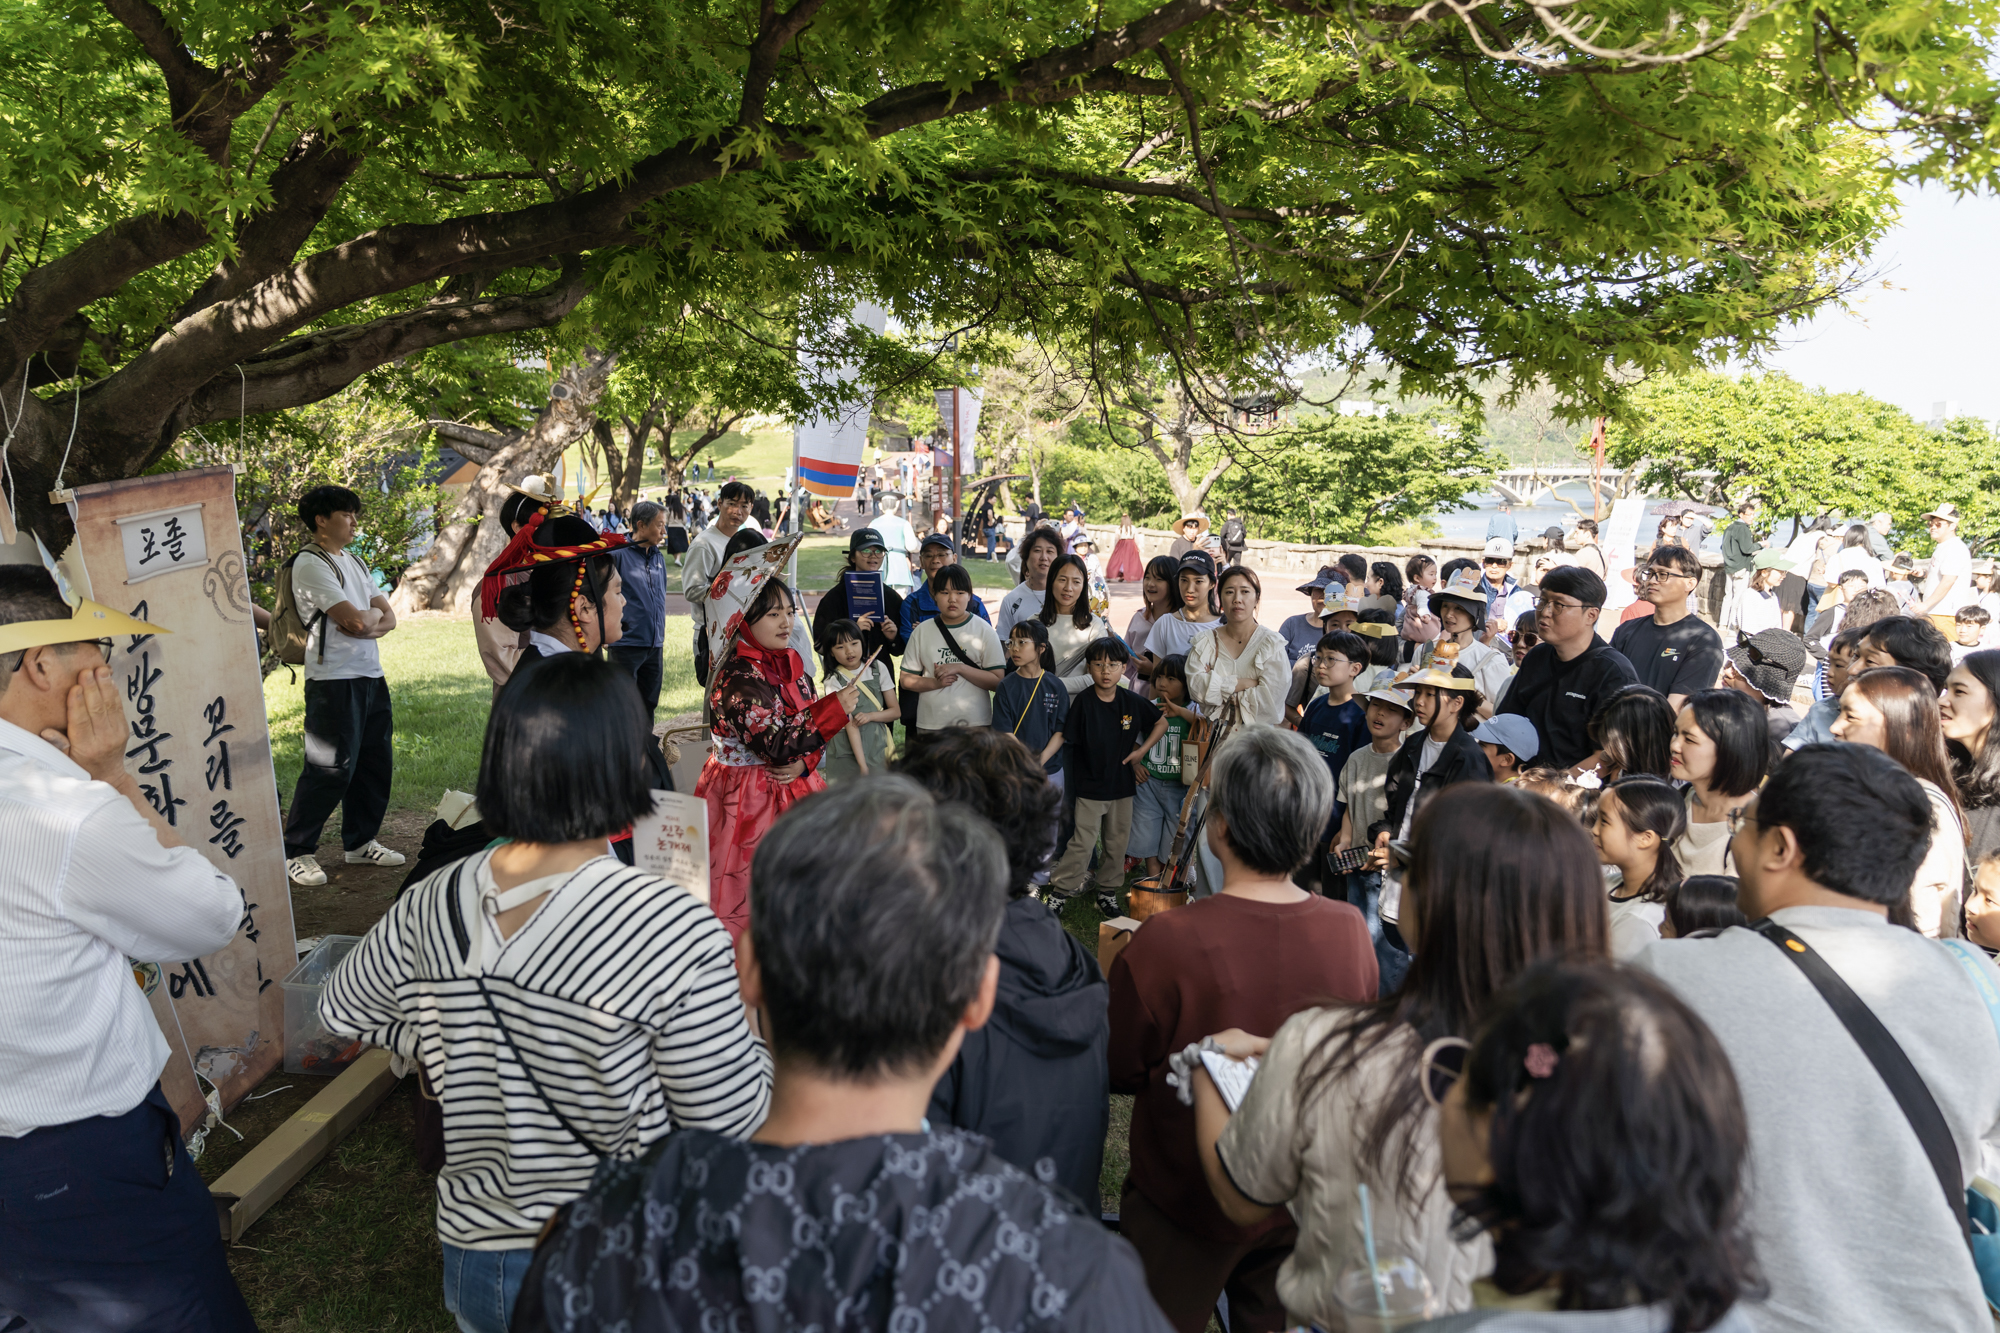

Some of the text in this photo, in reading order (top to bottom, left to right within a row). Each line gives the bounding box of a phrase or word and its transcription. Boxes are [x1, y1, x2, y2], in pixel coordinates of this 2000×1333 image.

[139, 517, 187, 565] 포졸
[1183, 754, 1197, 763] CELINE
[203, 696, 247, 859] 꼬리를
[661, 824, 684, 839] 진주
[657, 837, 692, 854] 논개제
